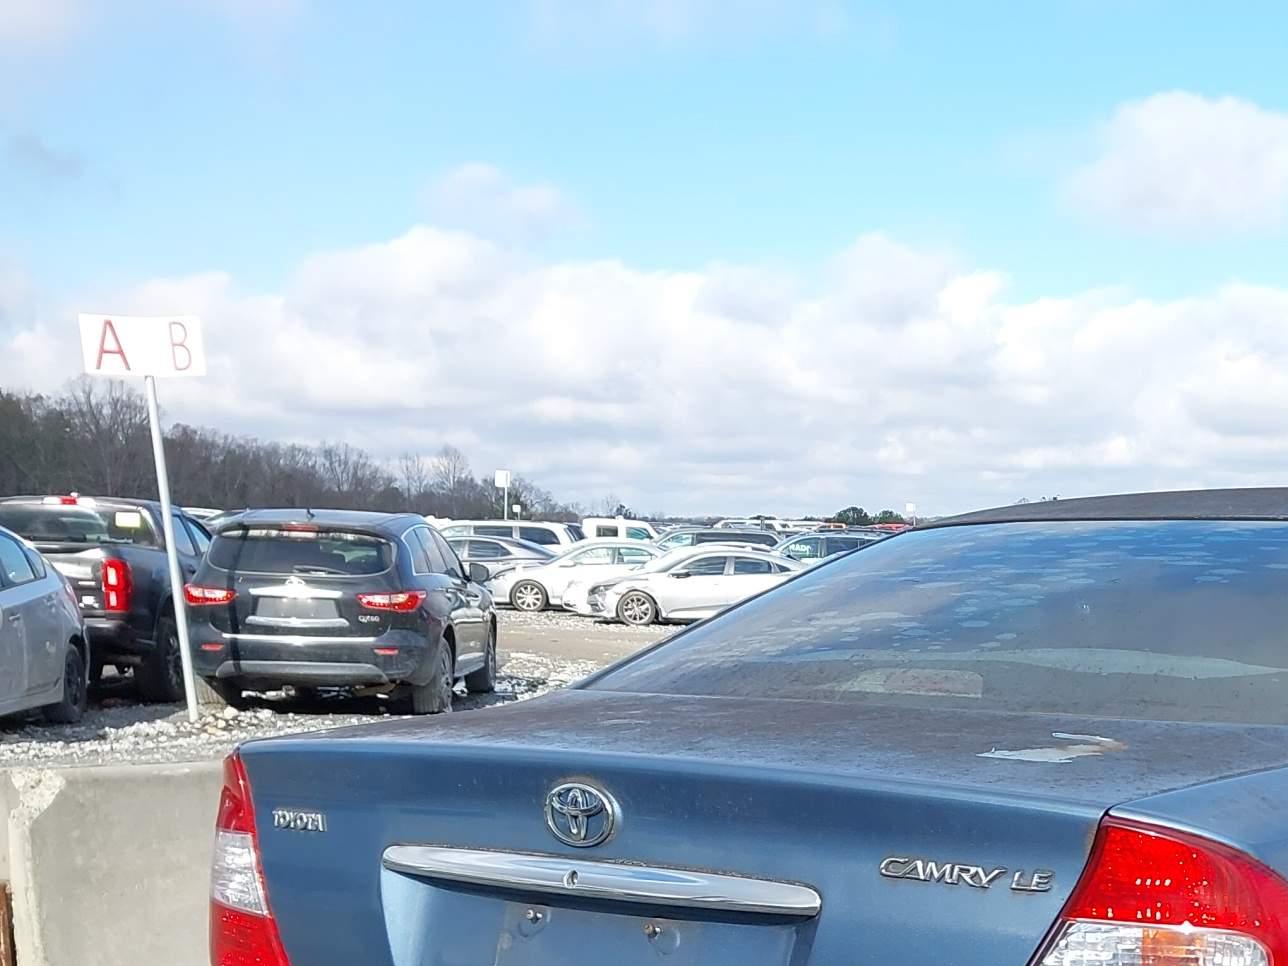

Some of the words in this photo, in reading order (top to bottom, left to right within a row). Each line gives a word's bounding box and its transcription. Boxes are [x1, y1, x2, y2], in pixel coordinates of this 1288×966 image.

[96, 319, 131, 371] A
[169, 321, 192, 371] B
[272, 809, 327, 832] TOYOTA
[879, 857, 1007, 889] CAMRY
[1010, 870, 1054, 892] LE
